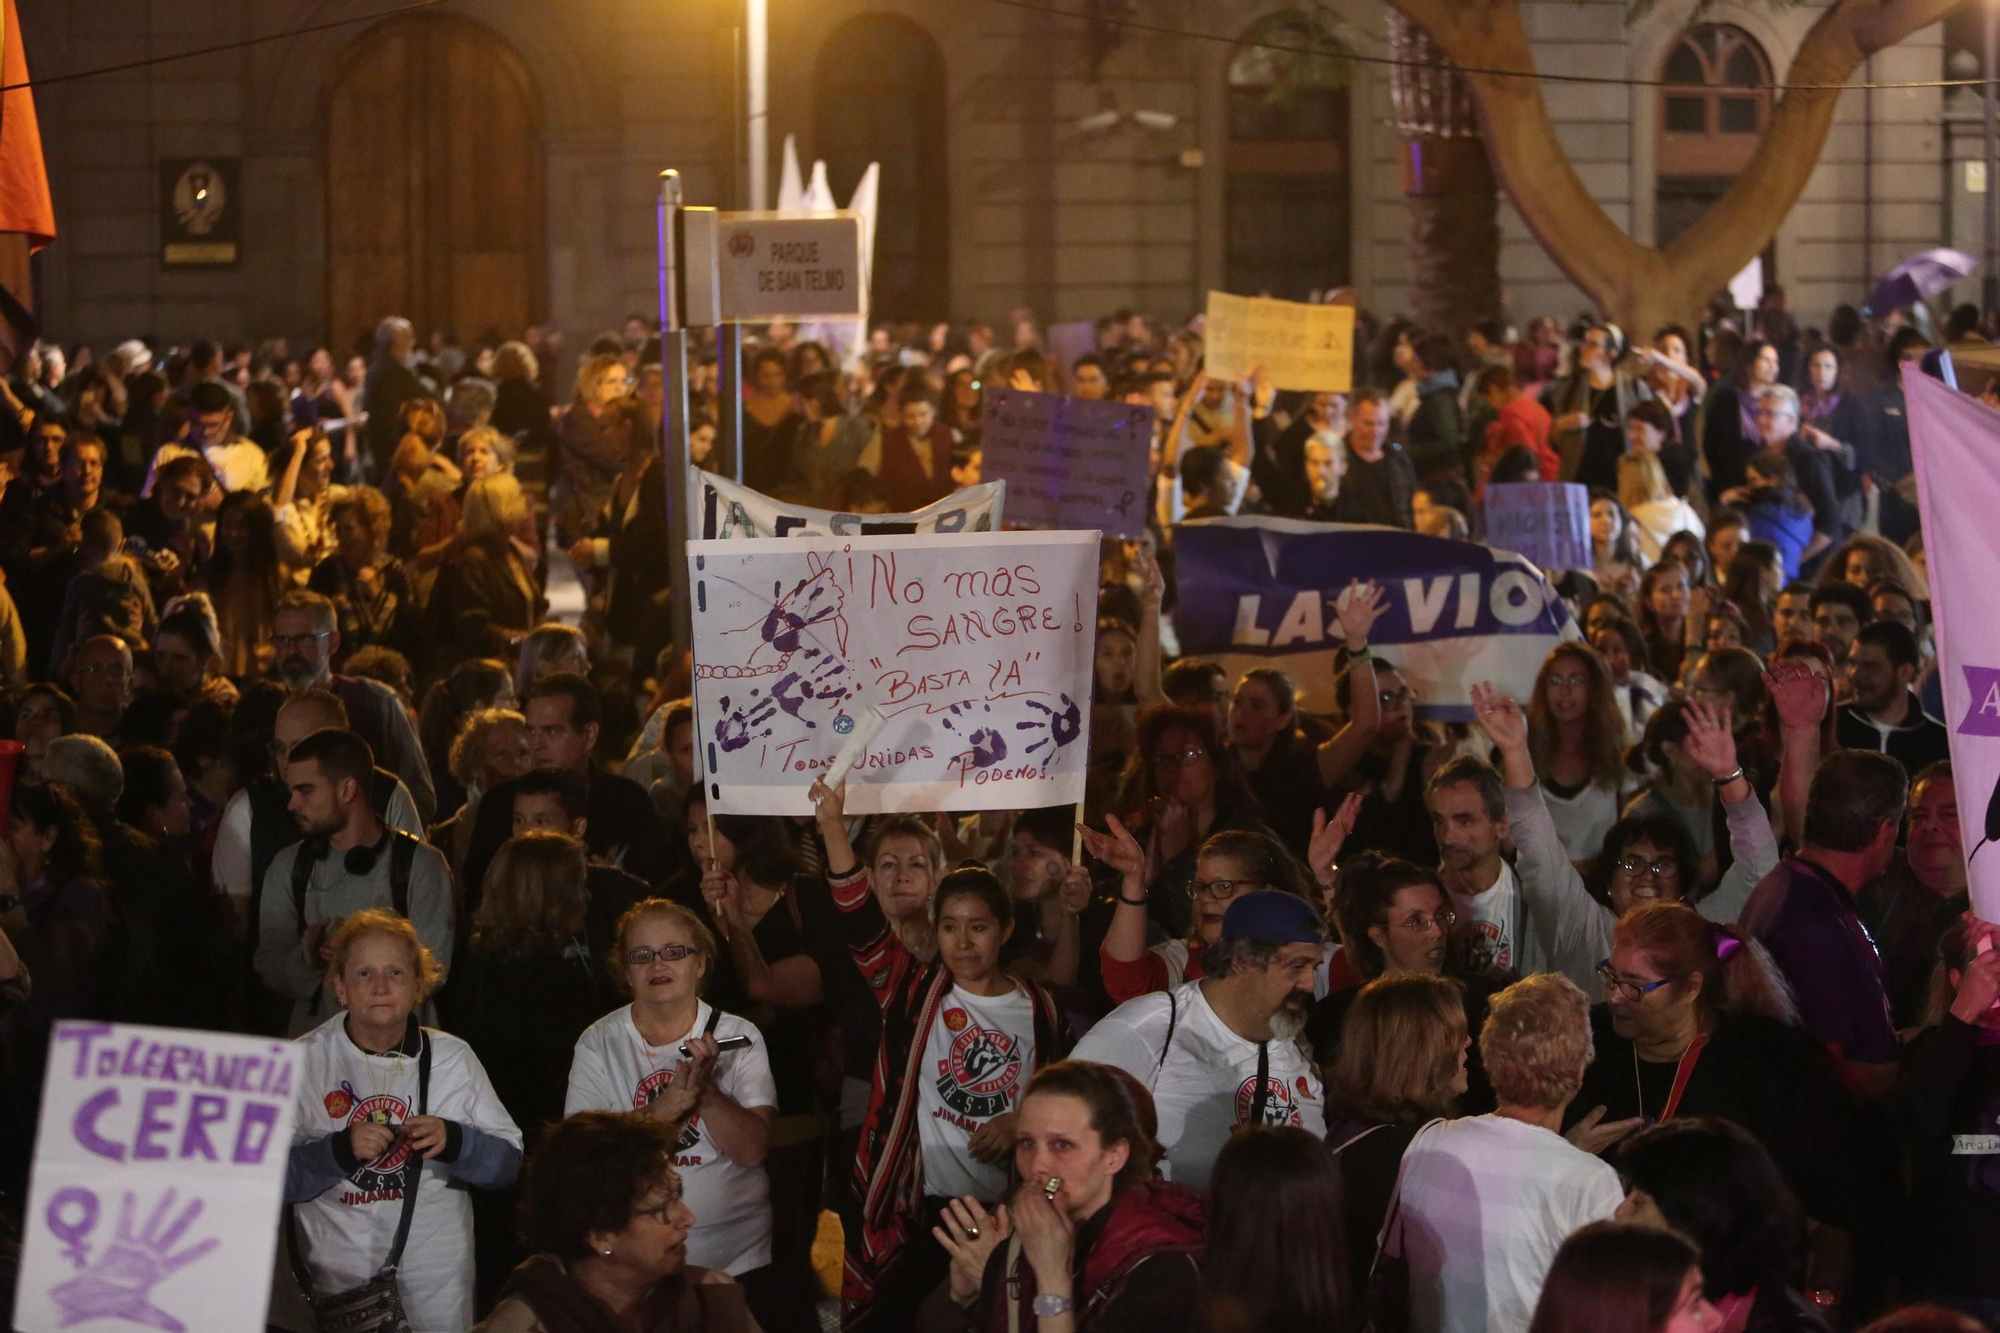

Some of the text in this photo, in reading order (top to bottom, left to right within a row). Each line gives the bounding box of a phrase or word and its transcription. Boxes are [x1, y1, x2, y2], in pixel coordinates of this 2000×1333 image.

[771, 241, 820, 264] PARQUE
[758, 270, 845, 292] DE SAN TELMO
[73, 1086, 281, 1164] CERO
